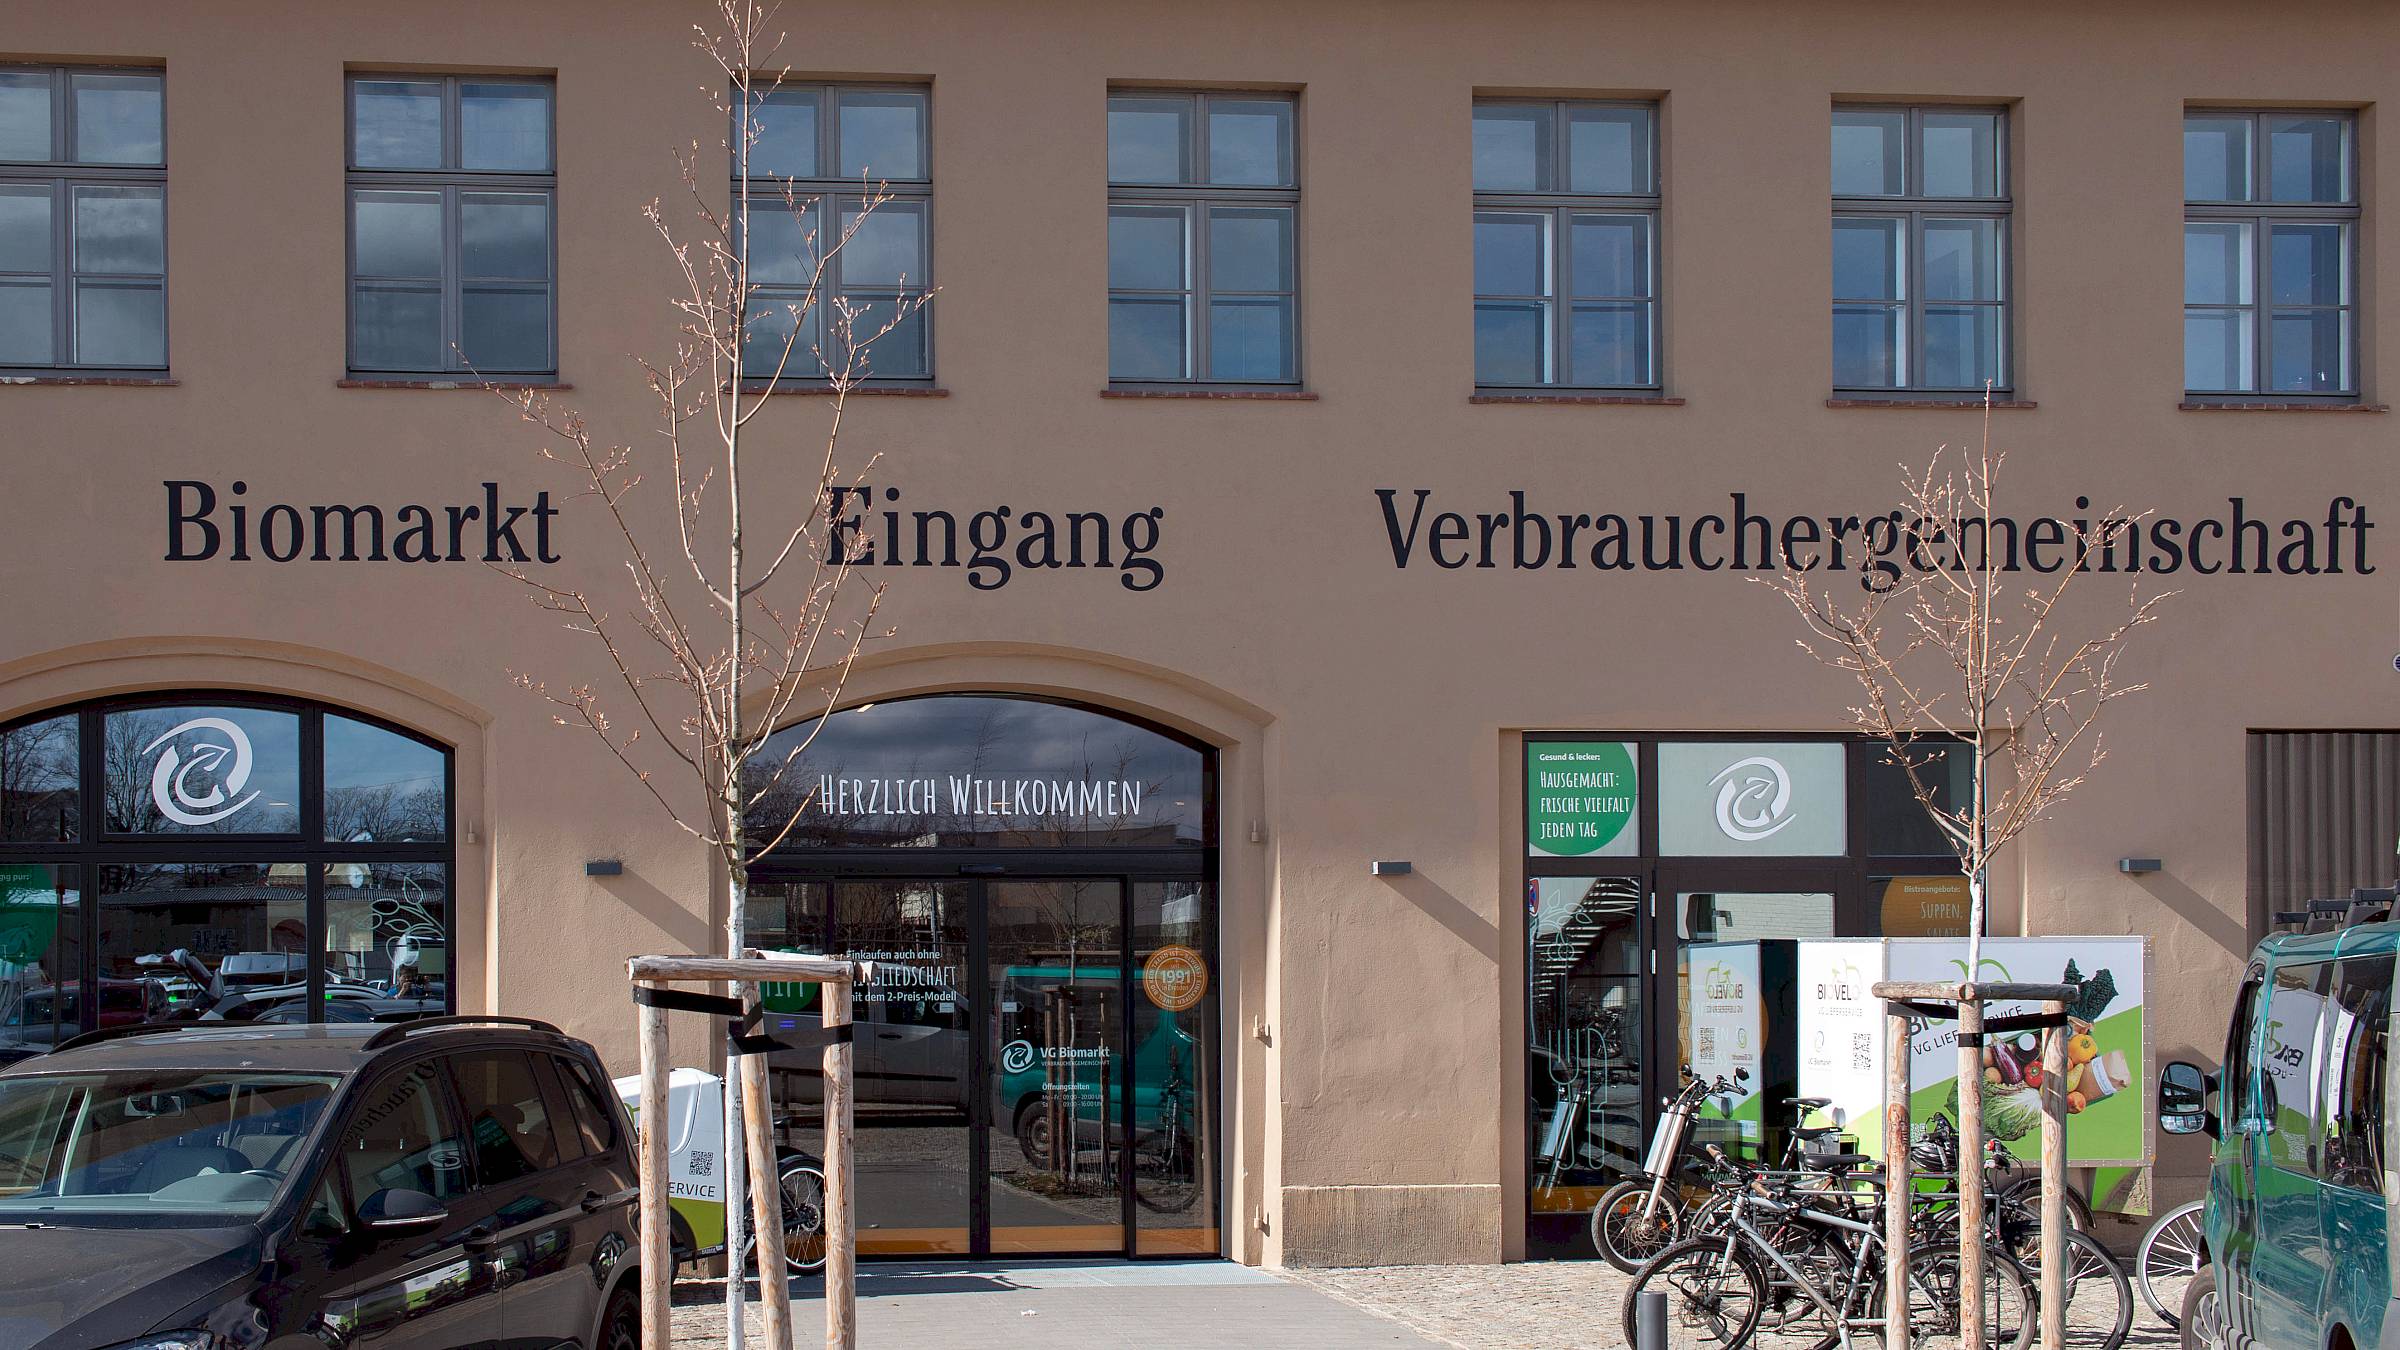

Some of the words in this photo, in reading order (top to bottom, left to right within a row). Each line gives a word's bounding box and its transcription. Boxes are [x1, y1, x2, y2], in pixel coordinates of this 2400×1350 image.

[163, 480, 562, 564] Biomarkt
[825, 487, 1165, 592] Eingang
[1374, 488, 2376, 594] Verbrauchergemeinschaft
[1539, 753, 1567, 761] Gesund
[1568, 753, 1575, 761] &
[1576, 752, 1601, 761] lecker:
[1540, 771, 1620, 789] HAUSGEMACHT:
[821, 774, 936, 815] HERZLICH
[949, 774, 1141, 817] WILLKOMMEN
[1540, 797, 1580, 813] FRISCHE
[1583, 797, 1630, 813] VIELFALT
[1540, 822, 1575, 840] JEDEN
[1578, 822, 1598, 838] TAG
[894, 949, 916, 960] auch
[917, 949, 941, 960] ohne
[1162, 970, 1191, 984] 1991
[864, 992, 886, 1002] dem
[887, 990, 957, 1002] 2-Preis-Modell
[1040, 1047, 1056, 1058] VG
[1059, 1046, 1110, 1058] Biomarkt
[1913, 1040, 1932, 1056] VG
